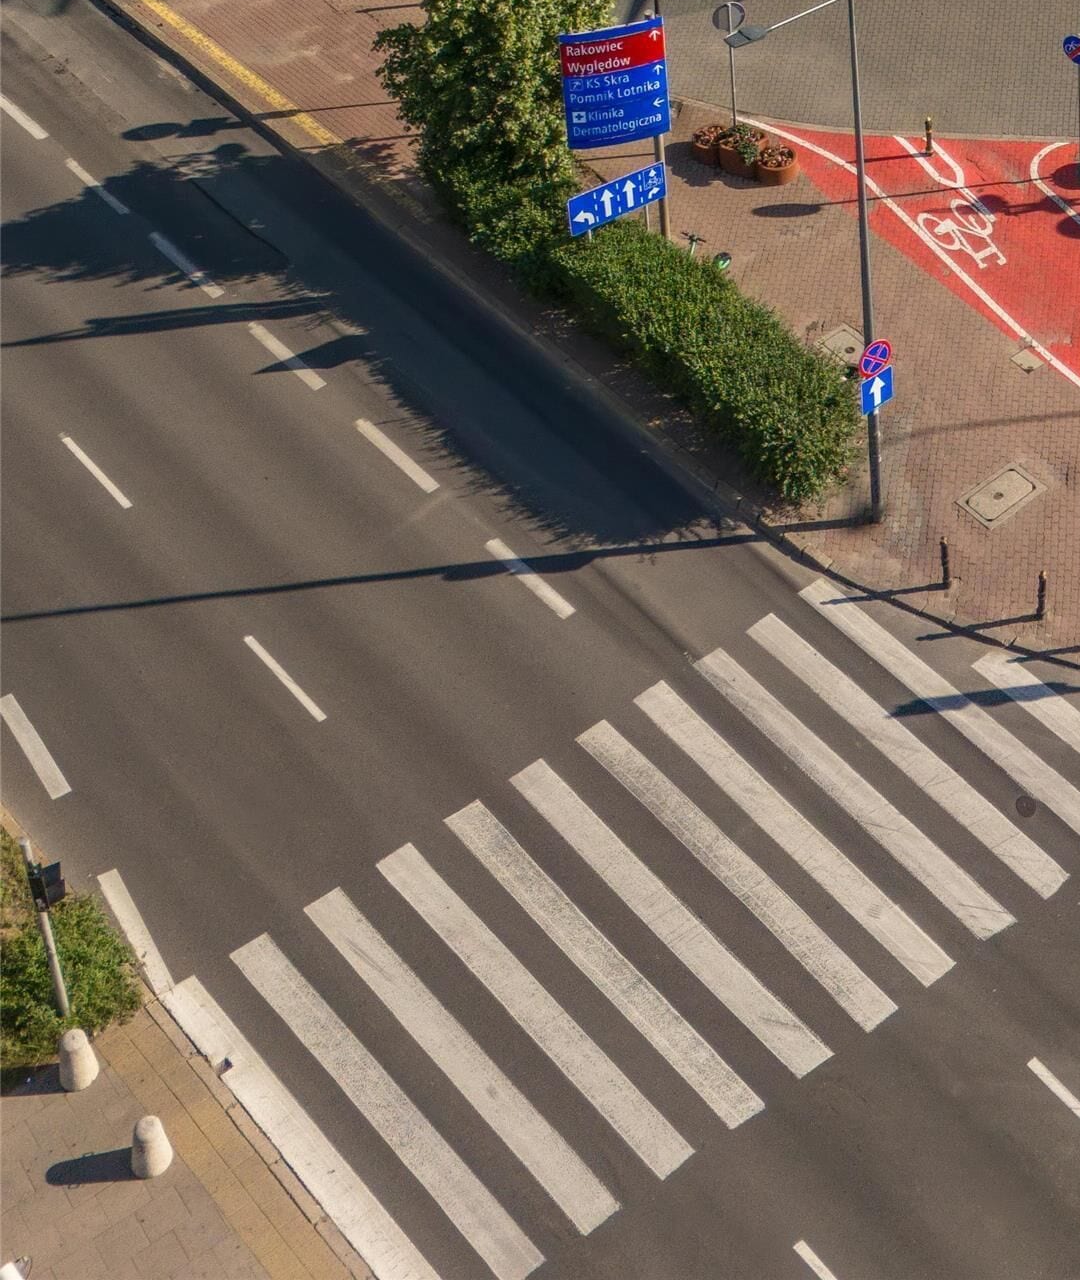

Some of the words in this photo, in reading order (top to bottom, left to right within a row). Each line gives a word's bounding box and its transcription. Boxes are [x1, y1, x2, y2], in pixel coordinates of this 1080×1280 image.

[566, 41, 624, 56] Rakowiec
[567, 56, 631, 76] Wyględów
[586, 78, 600, 89] KS
[603, 74, 629, 86] Skra
[569, 90, 614, 105] Pomnik
[617, 81, 660, 97] Lotnika
[587, 108, 624, 122] Klinika
[572, 113, 662, 137] Dermatologiczna
